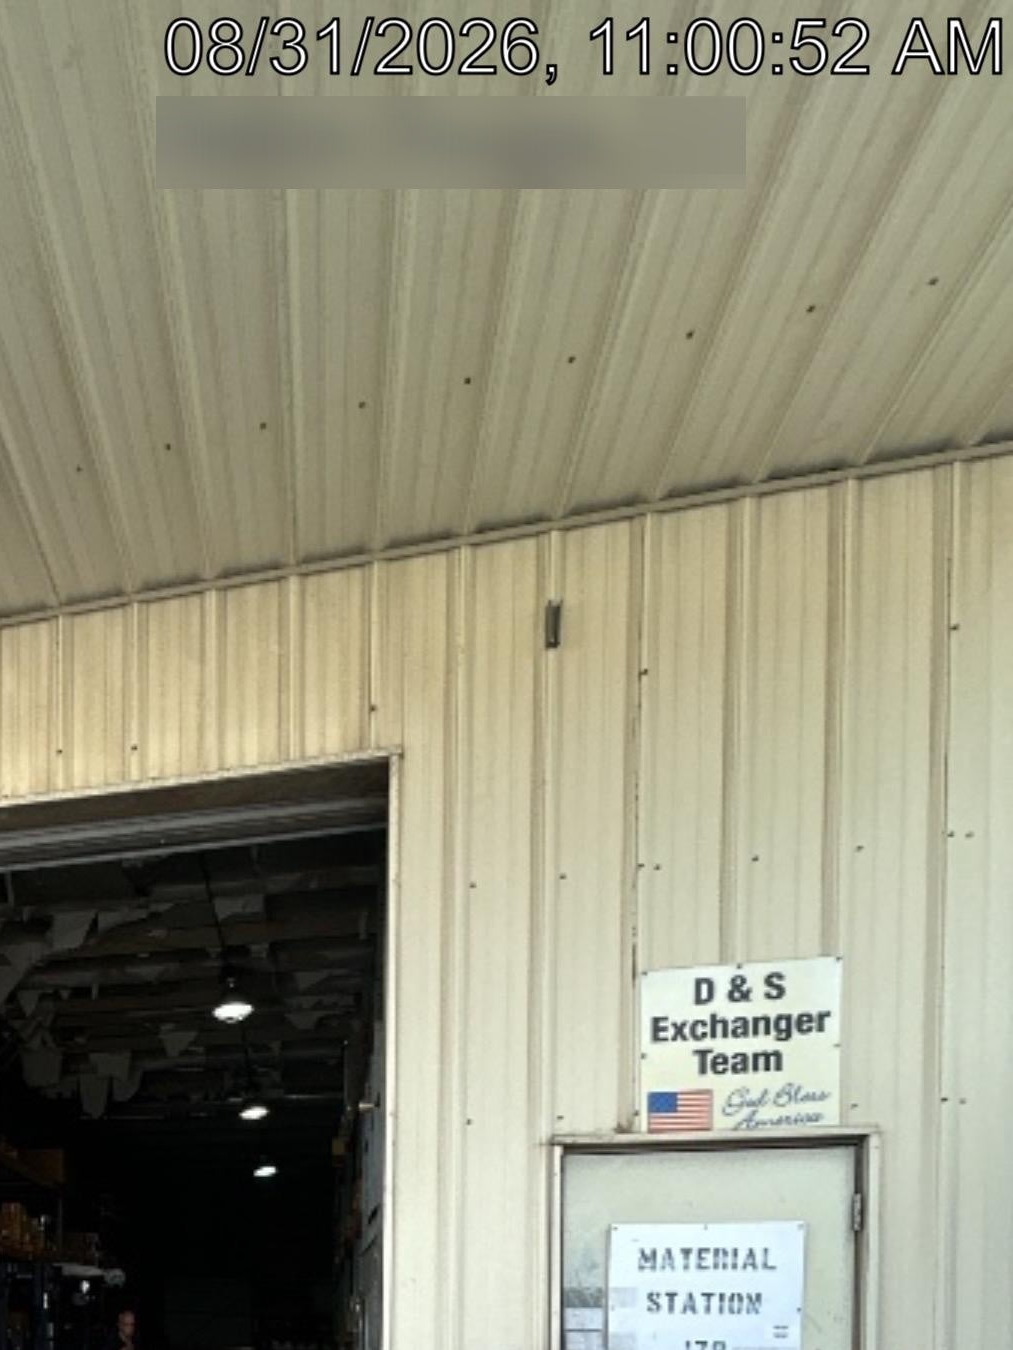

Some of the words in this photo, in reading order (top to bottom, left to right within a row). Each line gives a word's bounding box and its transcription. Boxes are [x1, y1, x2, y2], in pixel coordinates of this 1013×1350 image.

[694, 977, 714, 1005] D
[727, 974, 752, 1002] &
[764, 971, 786, 1000] S
[650, 1010, 831, 1042] Exchanger
[692, 1049, 783, 1076] Team
[638, 1247, 777, 1271] MATERIAL
[647, 1292, 763, 1315] STATION
